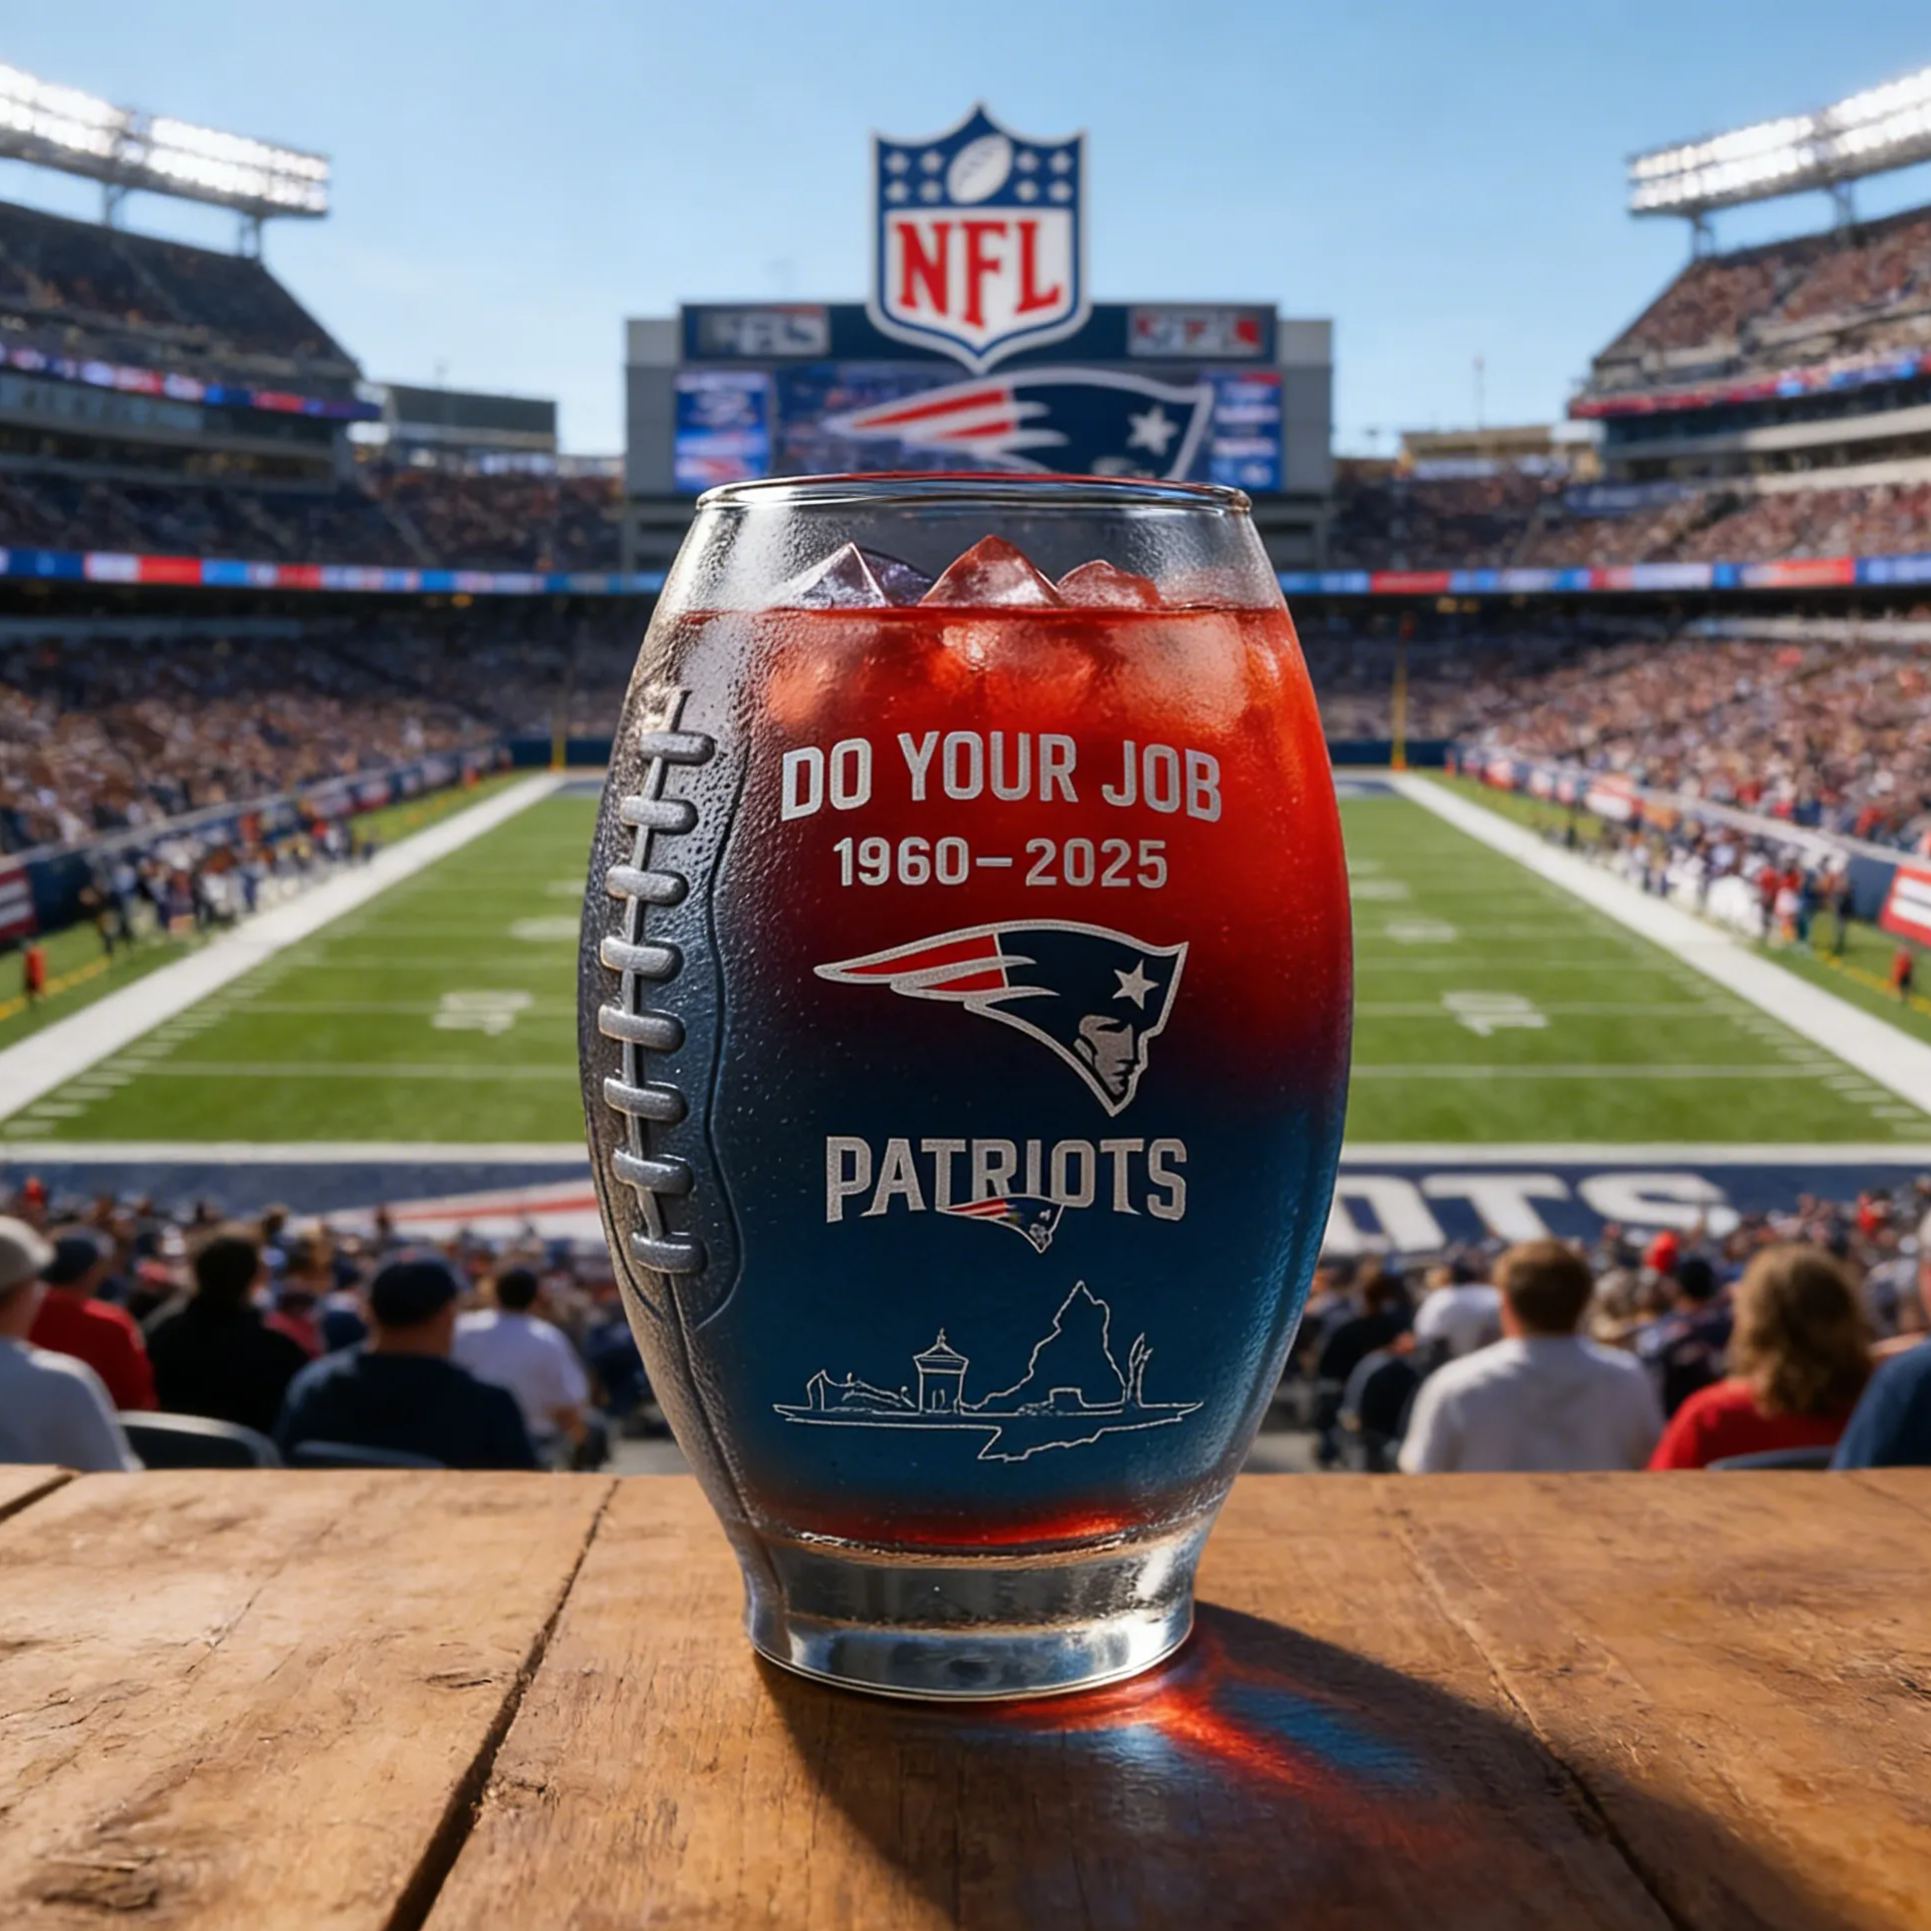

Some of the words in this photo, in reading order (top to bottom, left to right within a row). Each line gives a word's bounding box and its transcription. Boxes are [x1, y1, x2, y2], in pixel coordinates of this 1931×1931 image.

[895, 220, 1061, 327] NFL
[781, 738, 872, 822] DO
[897, 731, 1079, 802] YOUR
[1101, 741, 1222, 823] JOB
[826, 1136, 1187, 1222] PATRIOTS
